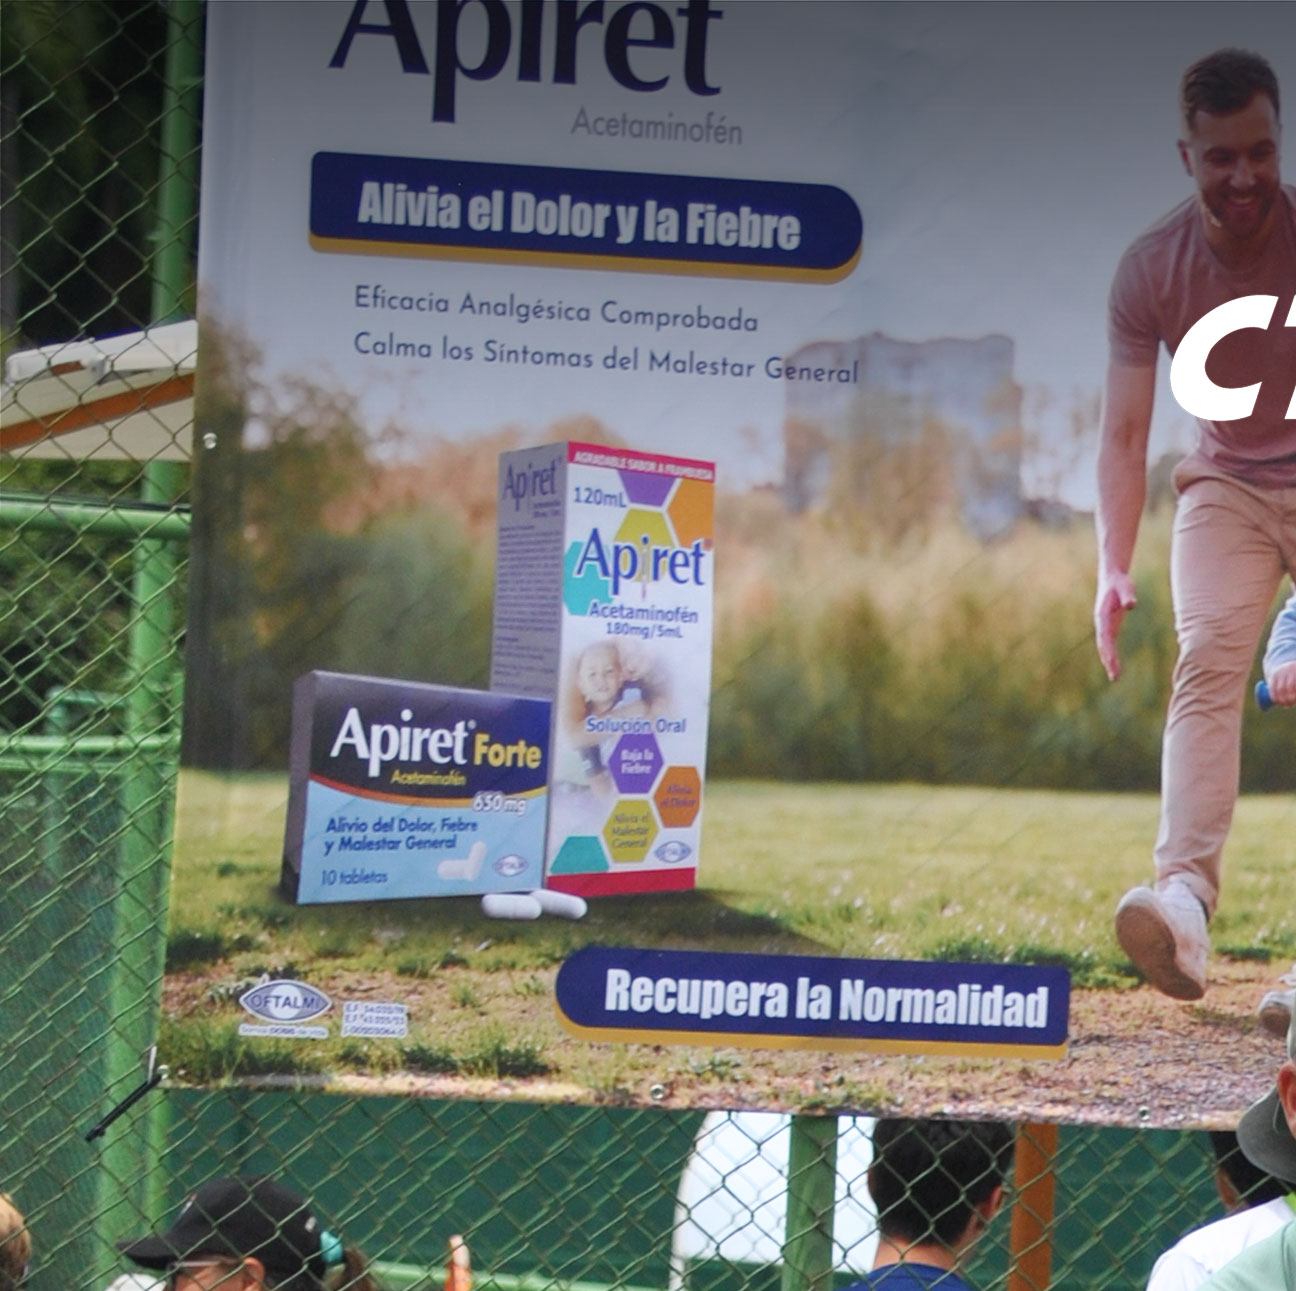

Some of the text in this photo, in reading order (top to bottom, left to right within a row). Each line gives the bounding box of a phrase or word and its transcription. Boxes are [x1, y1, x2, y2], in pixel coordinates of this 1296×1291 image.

[571, 107, 742, 145] Acetaminofén
[357, 181, 800, 251] Alivia el Dolor y la Fiebre
[354, 286, 758, 332] Eficacia Analgésica Comprobada
[354, 332, 858, 384] Calma los Síntomas del Malestar General
[574, 487, 626, 508] 120mL
[576, 528, 705, 595] Apiret
[590, 602, 698, 624] Acetaminofén
[586, 717, 686, 733] Solución Oral
[330, 707, 542, 777] Apiret Forte
[503, 796, 526, 816] mg
[326, 817, 367, 833] Alivio
[372, 818, 394, 833] del
[440, 818, 478, 832] Fiebre
[324, 835, 457, 856] y Malestar General
[321, 869, 389, 886] 10 tabletas
[605, 968, 1047, 1029] Recupera la Normalidad
